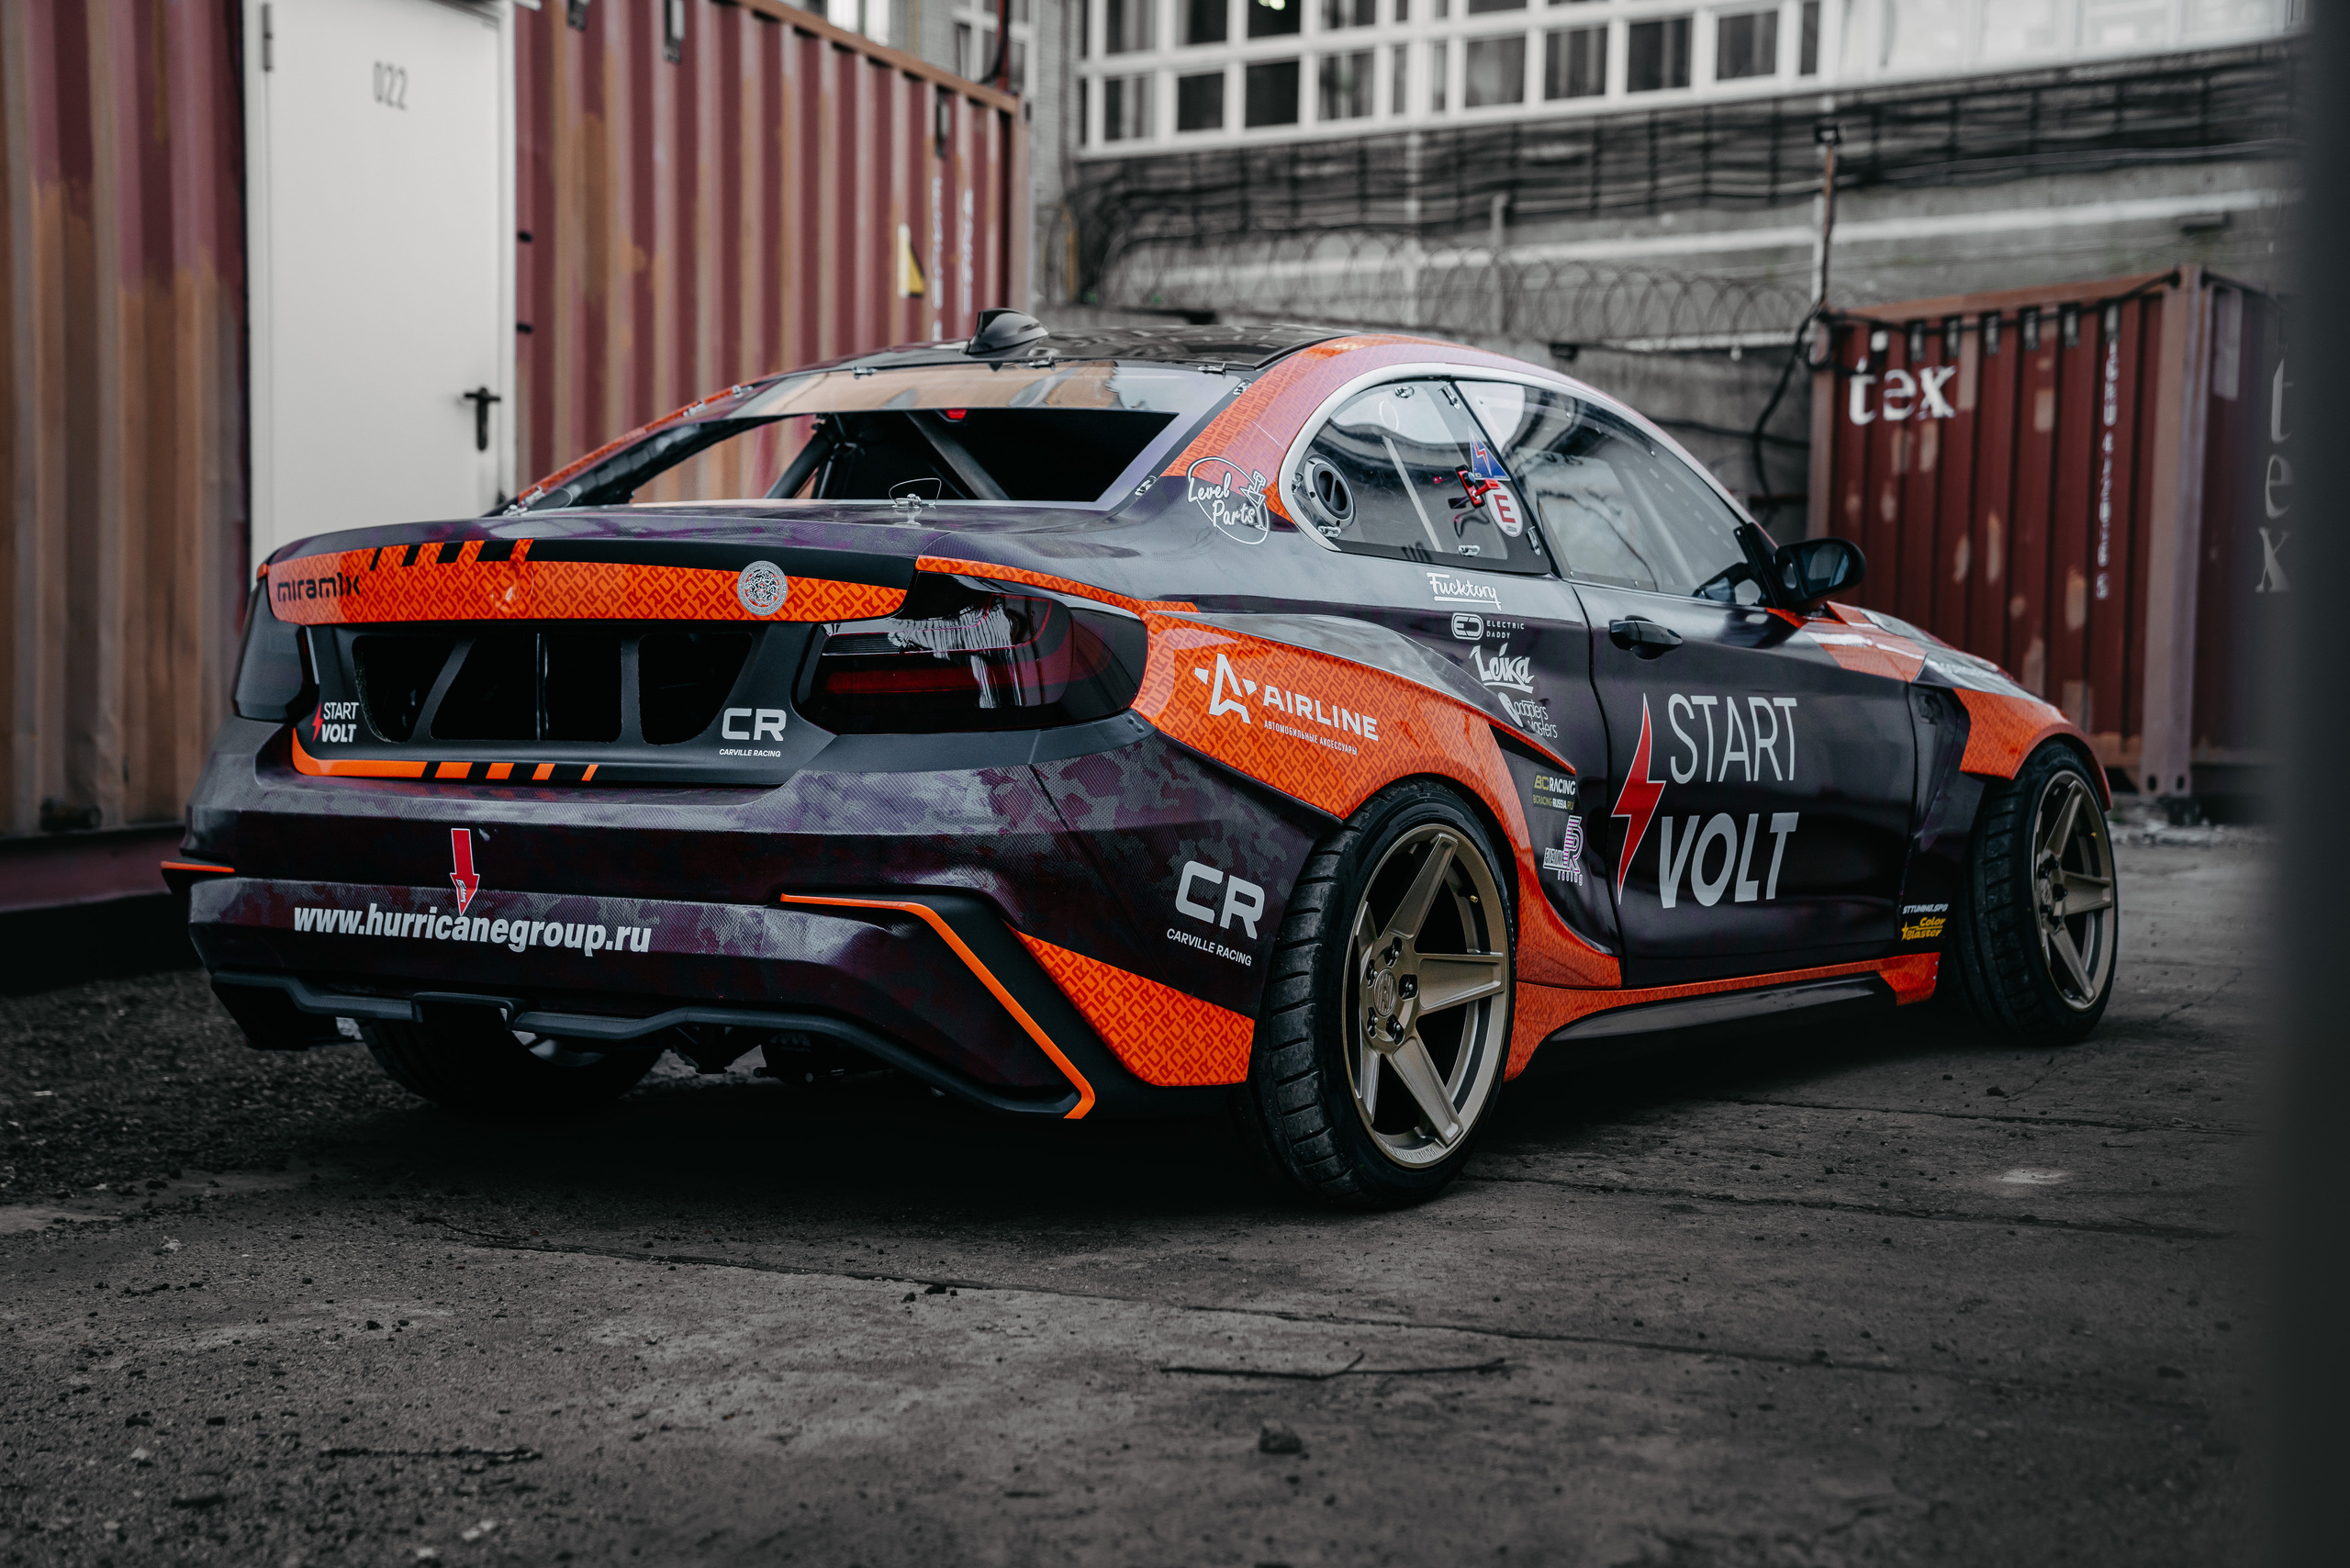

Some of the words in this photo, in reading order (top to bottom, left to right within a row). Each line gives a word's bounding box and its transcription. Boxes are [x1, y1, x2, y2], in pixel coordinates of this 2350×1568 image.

[373, 60, 409, 111] 022
[1849, 355, 1957, 427] tex
[1188, 472, 1232, 502] Level
[1212, 499, 1256, 527] Parts
[1493, 494, 1516, 523] E
[277, 572, 361, 602] miramix
[1426, 572, 1503, 610] Fucktory
[1486, 620, 1525, 630] ELECTRIC
[1486, 631, 1511, 639] DADDY
[323, 701, 360, 721] START
[722, 707, 788, 742] CR
[1263, 684, 1380, 742] AIRLINE
[321, 723, 358, 743] VOLT
[1263, 719, 1318, 745] АВТОМОБИЛЬНЫЕ
[1319, 735, 1358, 756] АКСЕССУАРЫ
[1668, 693, 1797, 784] START
[719, 748, 753, 756] CARVILLE
[753, 749, 781, 757] RACING
[1659, 812, 1799, 909] VOLT
[1175, 860, 1266, 940] CR
[294, 902, 653, 958] www.hurricanegroup.ru
[1906, 928, 1942, 941] Blaster
[1919, 916, 1947, 927] Color
[1167, 928, 1216, 954] CARVILLE
[1215, 944, 1253, 967] RACING
